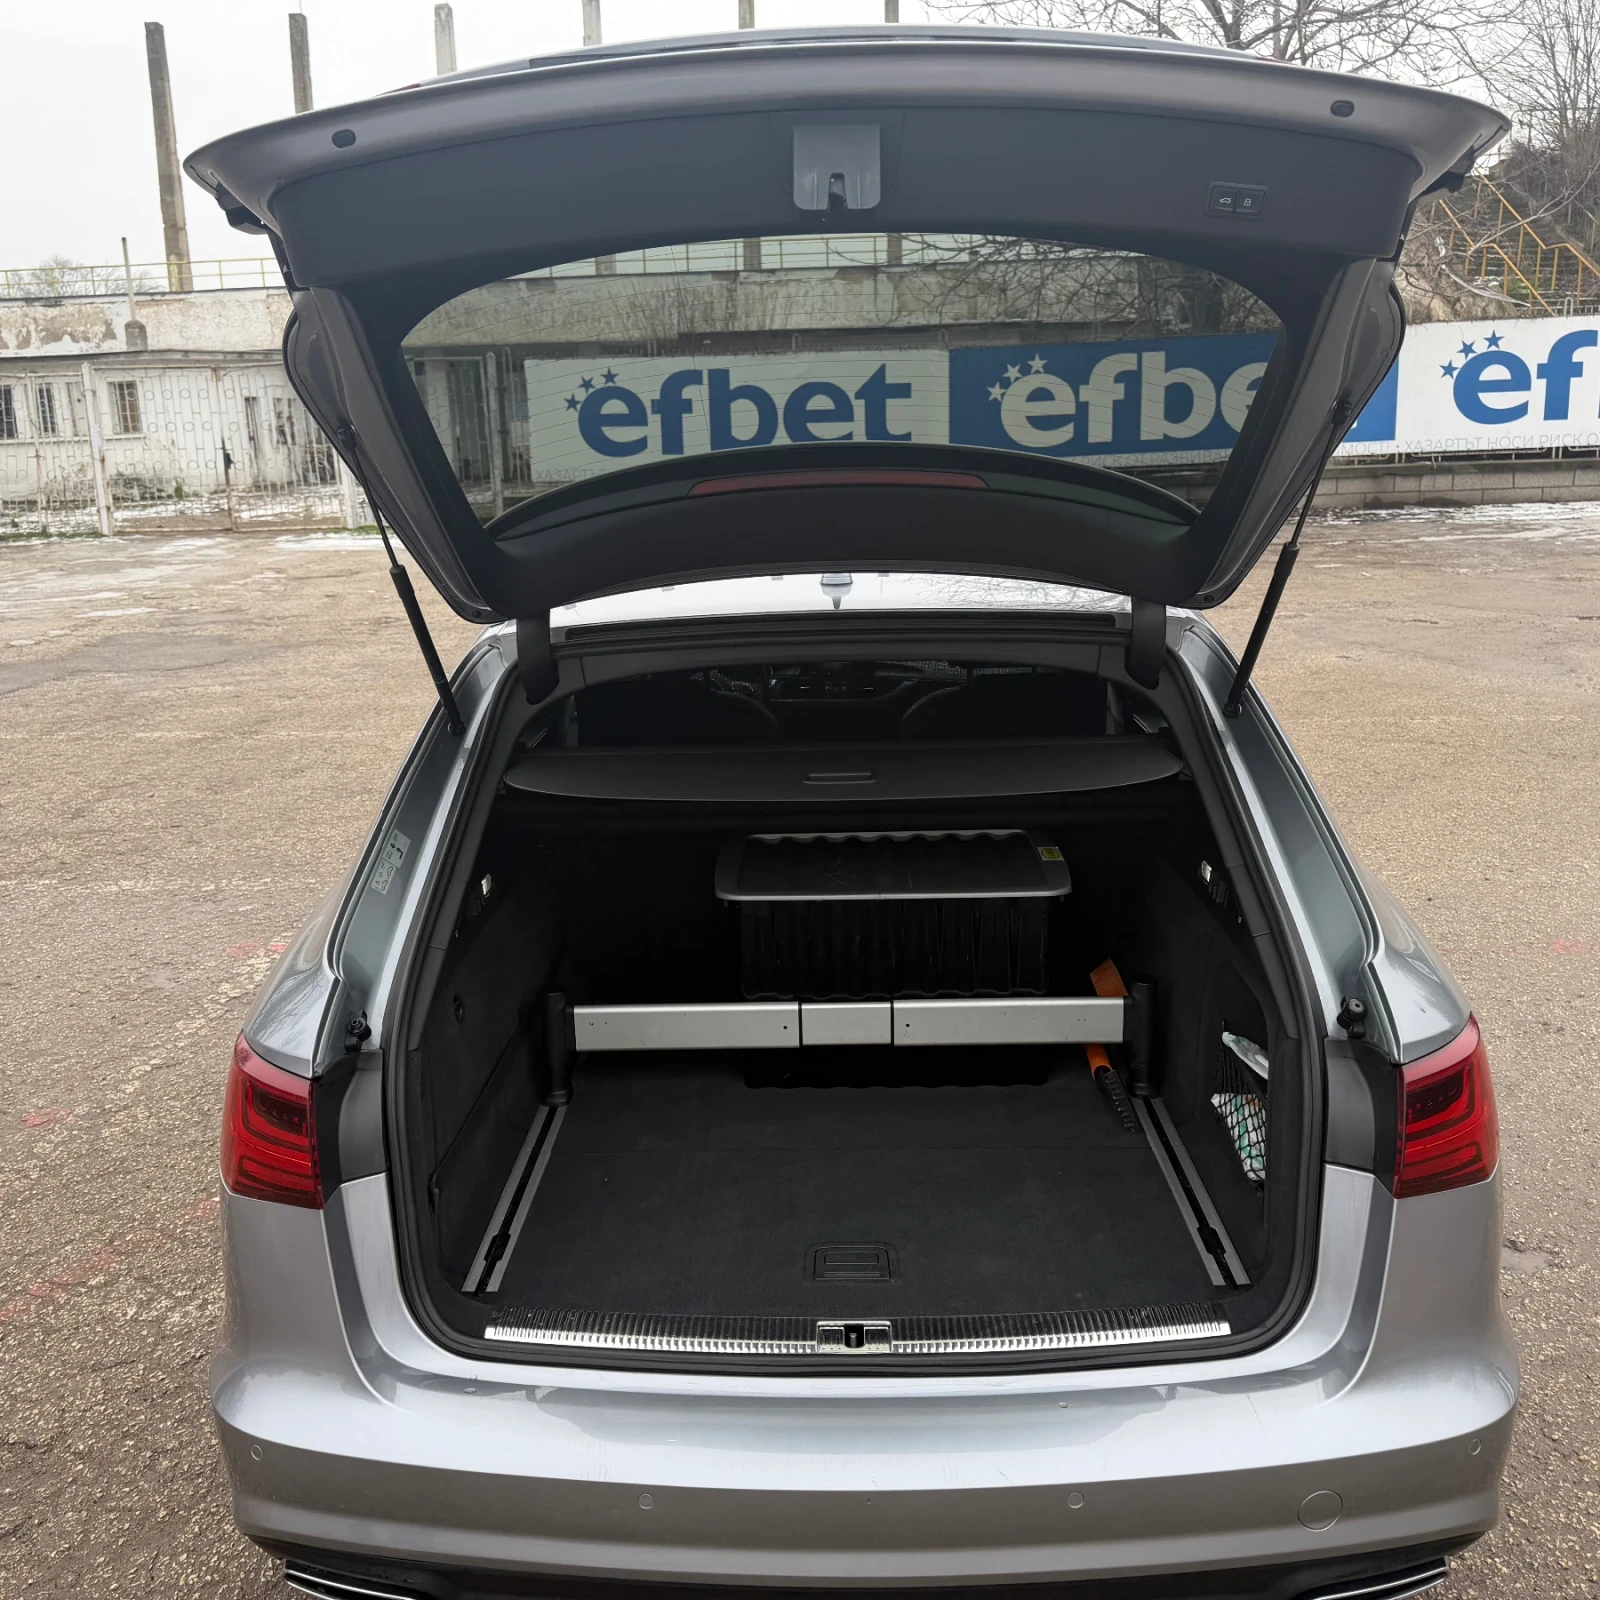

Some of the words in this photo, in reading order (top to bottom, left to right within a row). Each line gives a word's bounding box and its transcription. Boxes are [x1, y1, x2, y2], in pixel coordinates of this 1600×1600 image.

[579, 363, 912, 457] efbet
[1453, 329, 1600, 425] ef
[1404, 437, 1484, 452] ХАЗАРТЪТ
[1487, 435, 1534, 449] НОСИ
[1539, 432, 1583, 447] РИСК
[1586, 432, 1600, 446] О
